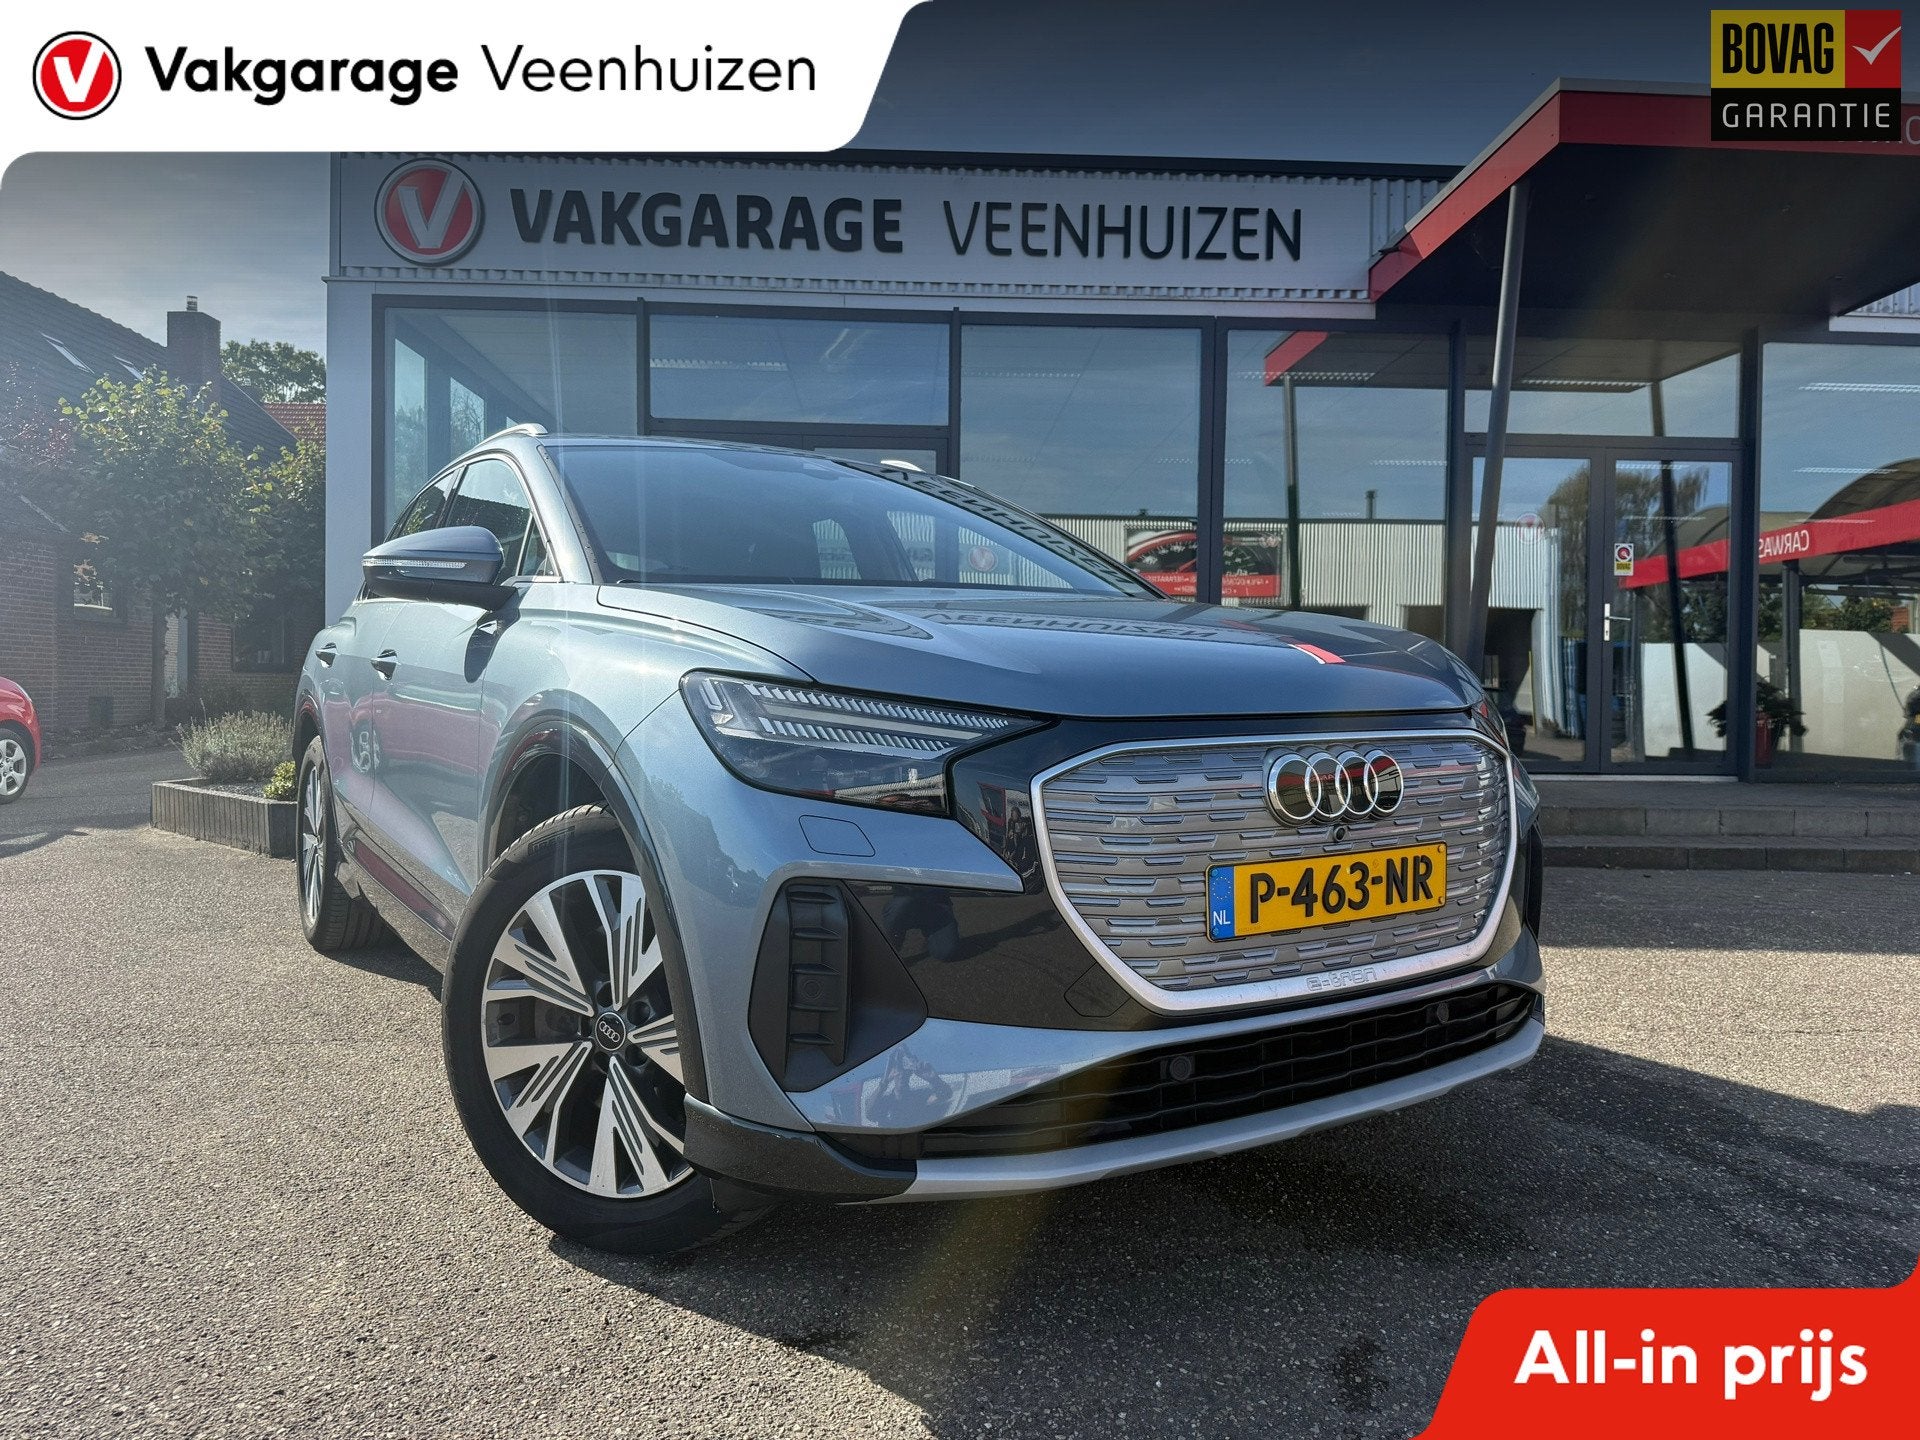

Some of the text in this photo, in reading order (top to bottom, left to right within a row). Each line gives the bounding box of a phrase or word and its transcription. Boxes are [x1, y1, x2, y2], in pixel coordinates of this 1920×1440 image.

[509, 188, 904, 254] VAKGARAGE
[943, 200, 1302, 261] VEENHUIZEN
[1250, 855, 1434, 923] P-463-NR
[1212, 910, 1231, 926] NL
[1306, 967, 1377, 991] e-tron
